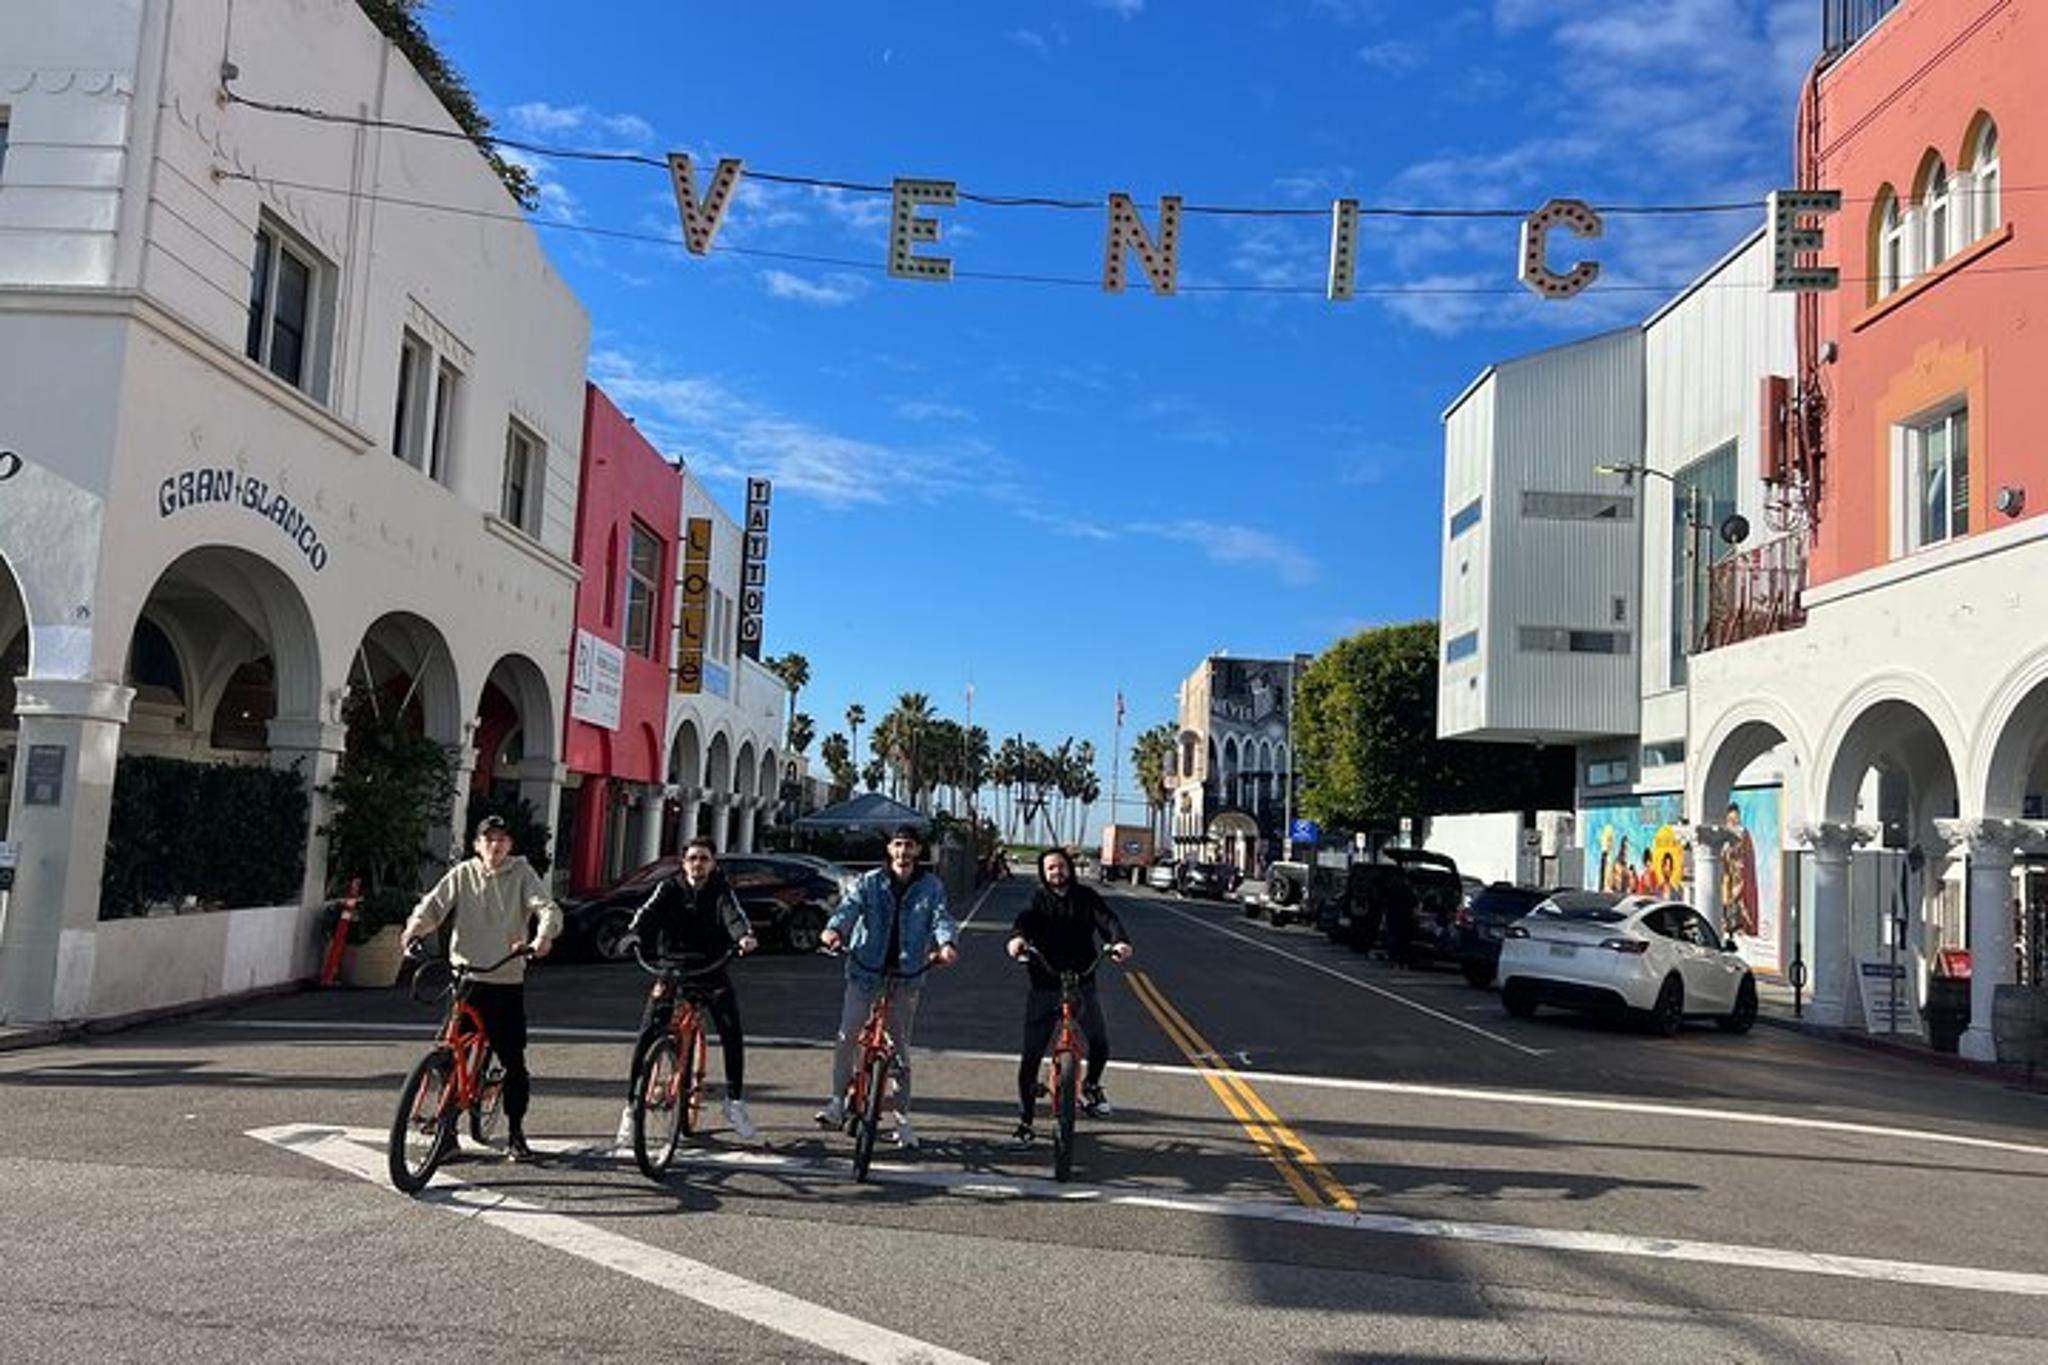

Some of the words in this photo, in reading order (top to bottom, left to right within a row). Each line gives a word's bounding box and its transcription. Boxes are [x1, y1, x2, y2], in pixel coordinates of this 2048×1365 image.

[667, 152, 1842, 300] VENICE
[159, 468, 234, 518] GRAN
[744, 482, 765, 637] TATTOO
